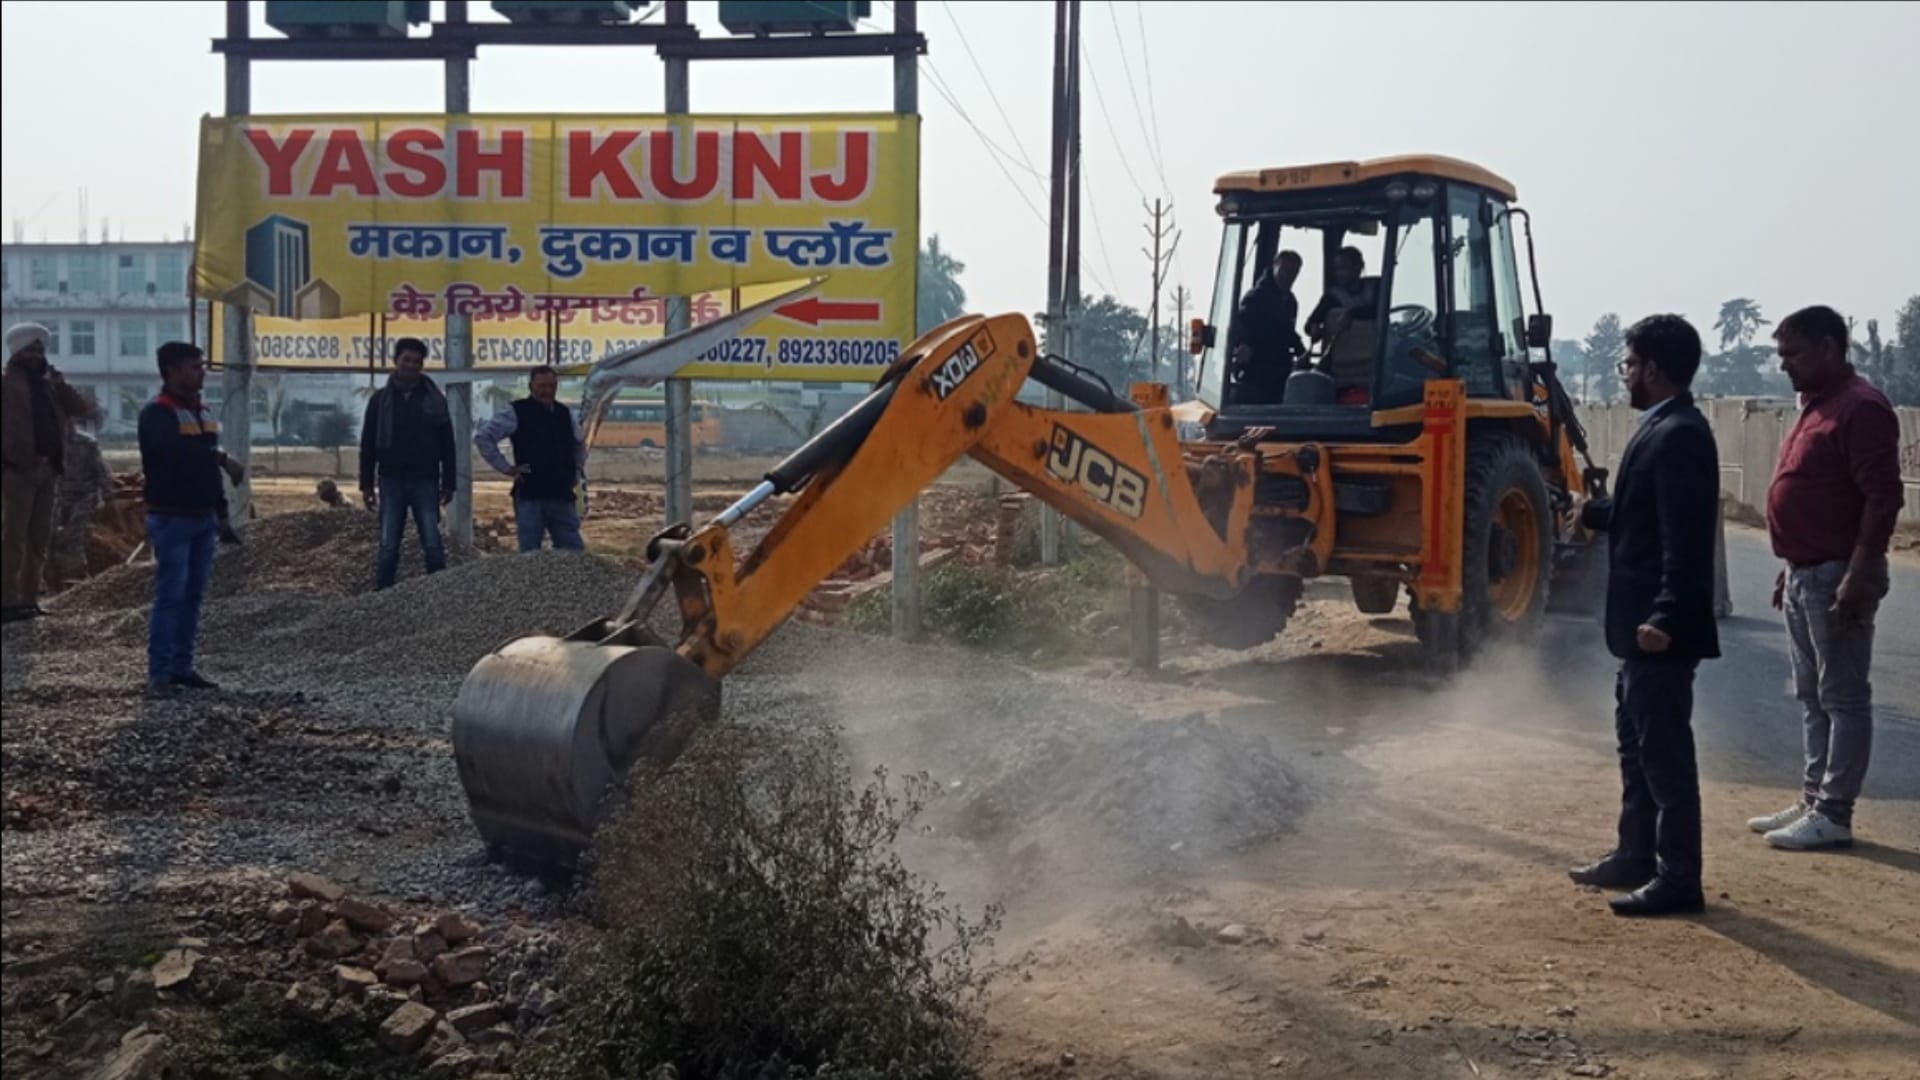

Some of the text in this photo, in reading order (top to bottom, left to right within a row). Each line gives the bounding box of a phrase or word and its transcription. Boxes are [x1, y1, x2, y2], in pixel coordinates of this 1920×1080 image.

[243, 128, 869, 201] YASH KUNJ
[348, 222, 893, 278] मकान, दुकान व प्लॉट
[391, 285, 436, 315] के
[445, 284, 524, 316] लिये
[778, 338, 898, 366] 8923360205
[1049, 438, 1149, 520] JCB
